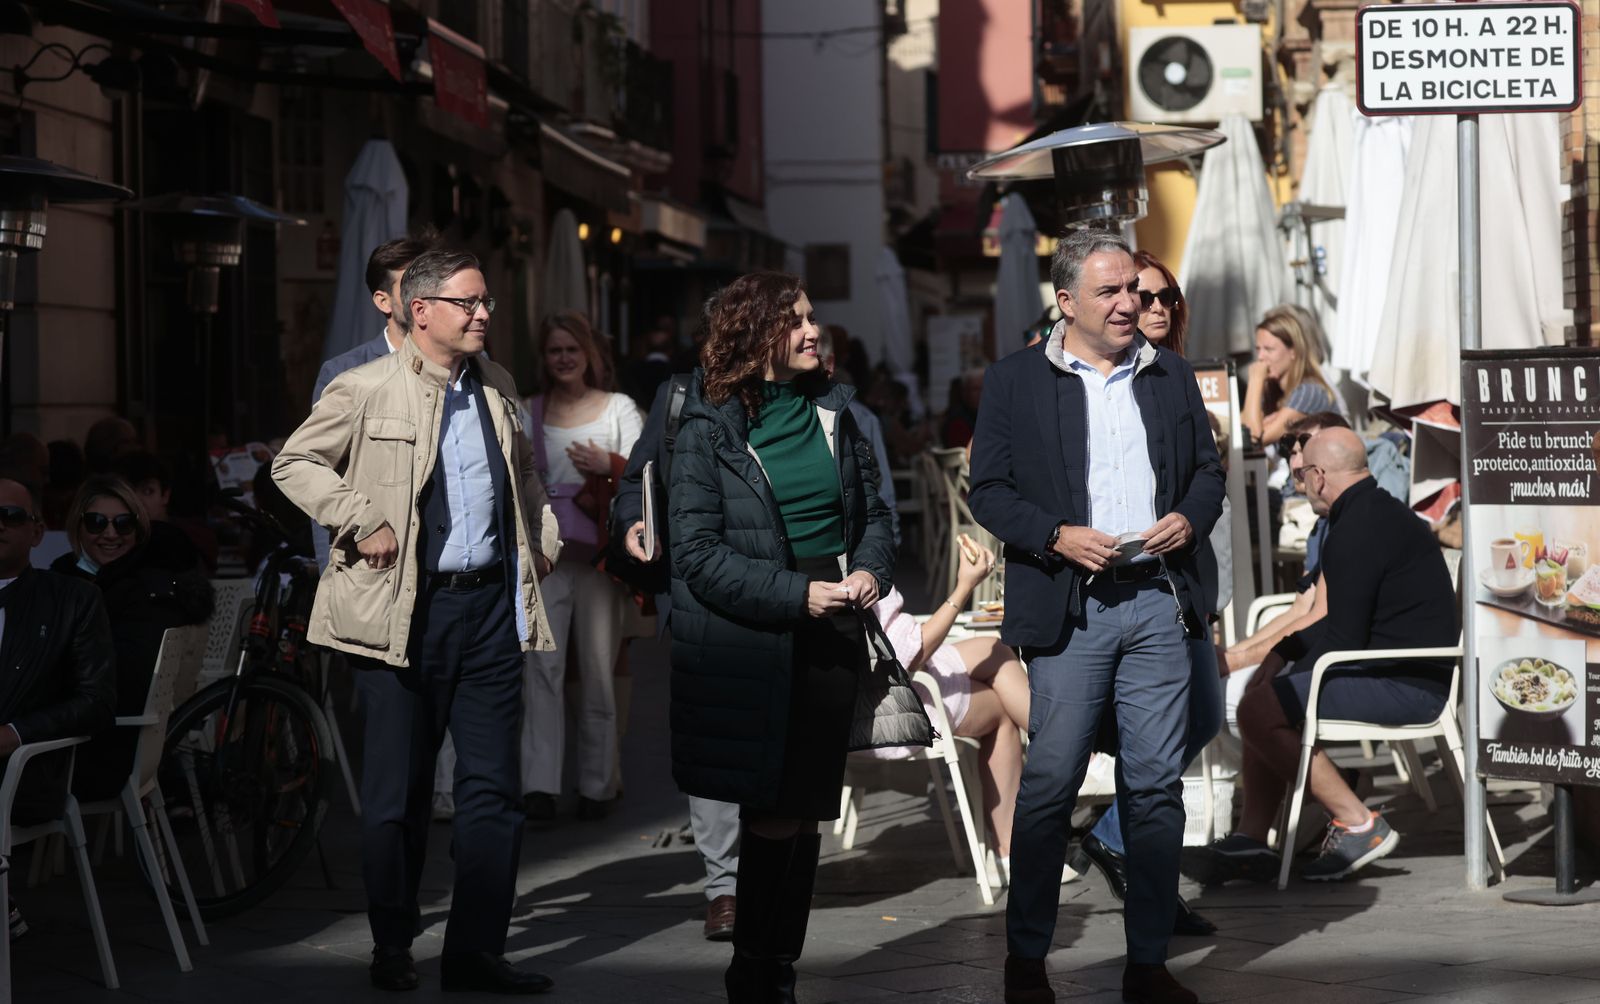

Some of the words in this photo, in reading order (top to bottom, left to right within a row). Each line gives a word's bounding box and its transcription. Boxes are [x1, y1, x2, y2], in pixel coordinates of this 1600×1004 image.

[1369, 19, 1402, 39] DE
[1412, 18, 1438, 38] 10
[1445, 18, 1468, 37] H.
[1479, 17, 1496, 36] A
[1506, 16, 1537, 36] 22
[1544, 15, 1567, 35] H.
[1372, 48, 1522, 70] DESMONTE
[1531, 47, 1565, 67] DE
[1380, 81, 1413, 101] LA
[1421, 78, 1557, 100] BICICLETA
[1477, 365, 1600, 403] BRUNC
[1557, 405, 1600, 414] PAPEL
[1498, 430, 1527, 449] Pide
[1529, 433, 1542, 449] tu
[1544, 430, 1594, 449] brunch
[1509, 475, 1556, 502] ¡muchos
[1558, 473, 1591, 498] más!
[1486, 742, 1530, 765] También
[1529, 746, 1545, 766] bol
[1545, 748, 1559, 767] de
[1557, 747, 1583, 772] fruta
